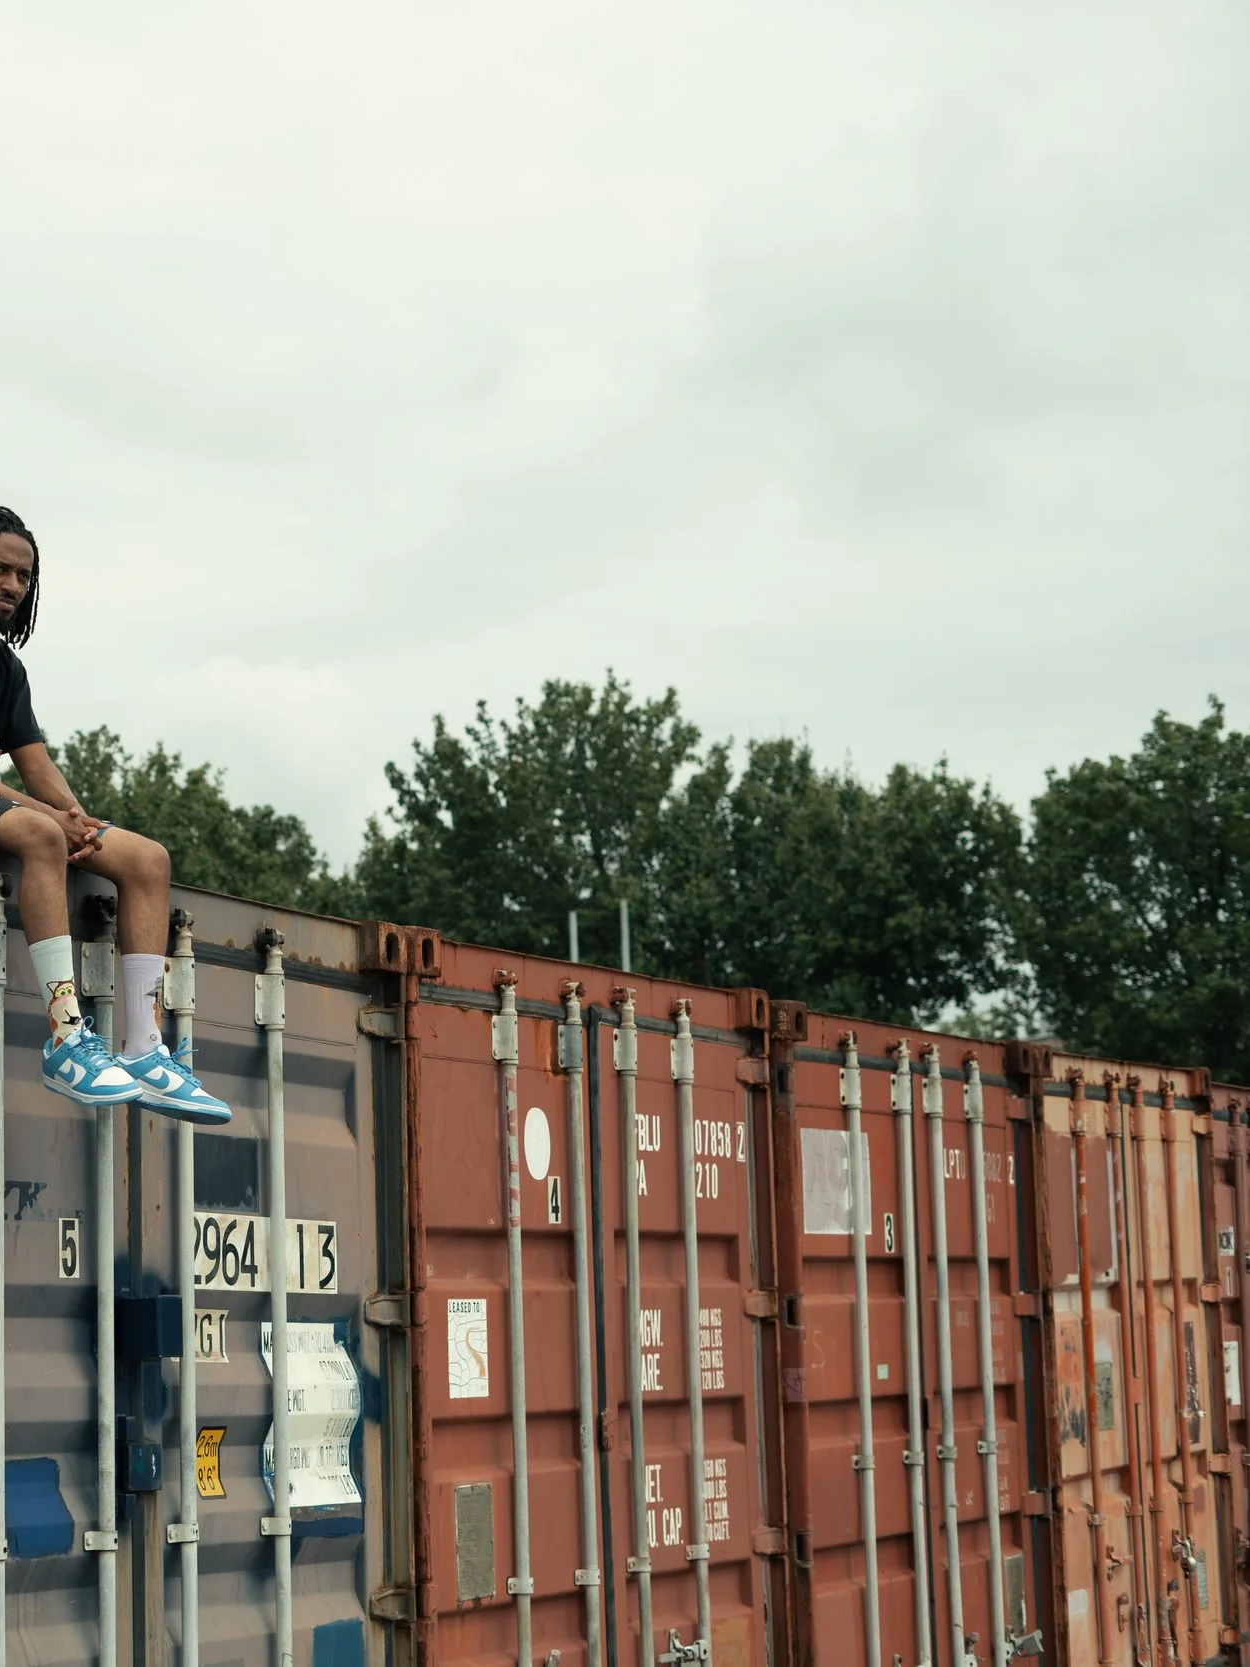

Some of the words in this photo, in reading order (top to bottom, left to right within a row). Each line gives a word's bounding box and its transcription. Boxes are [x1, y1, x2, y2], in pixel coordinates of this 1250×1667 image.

[550, 1177, 560, 1222] 4
[61, 1219, 77, 1277] 5
[885, 1214, 893, 1253] 3
[448, 1302, 471, 1314] LEASED
[473, 1301, 481, 1314] TO
[662, 1506, 684, 1547] CAP.
